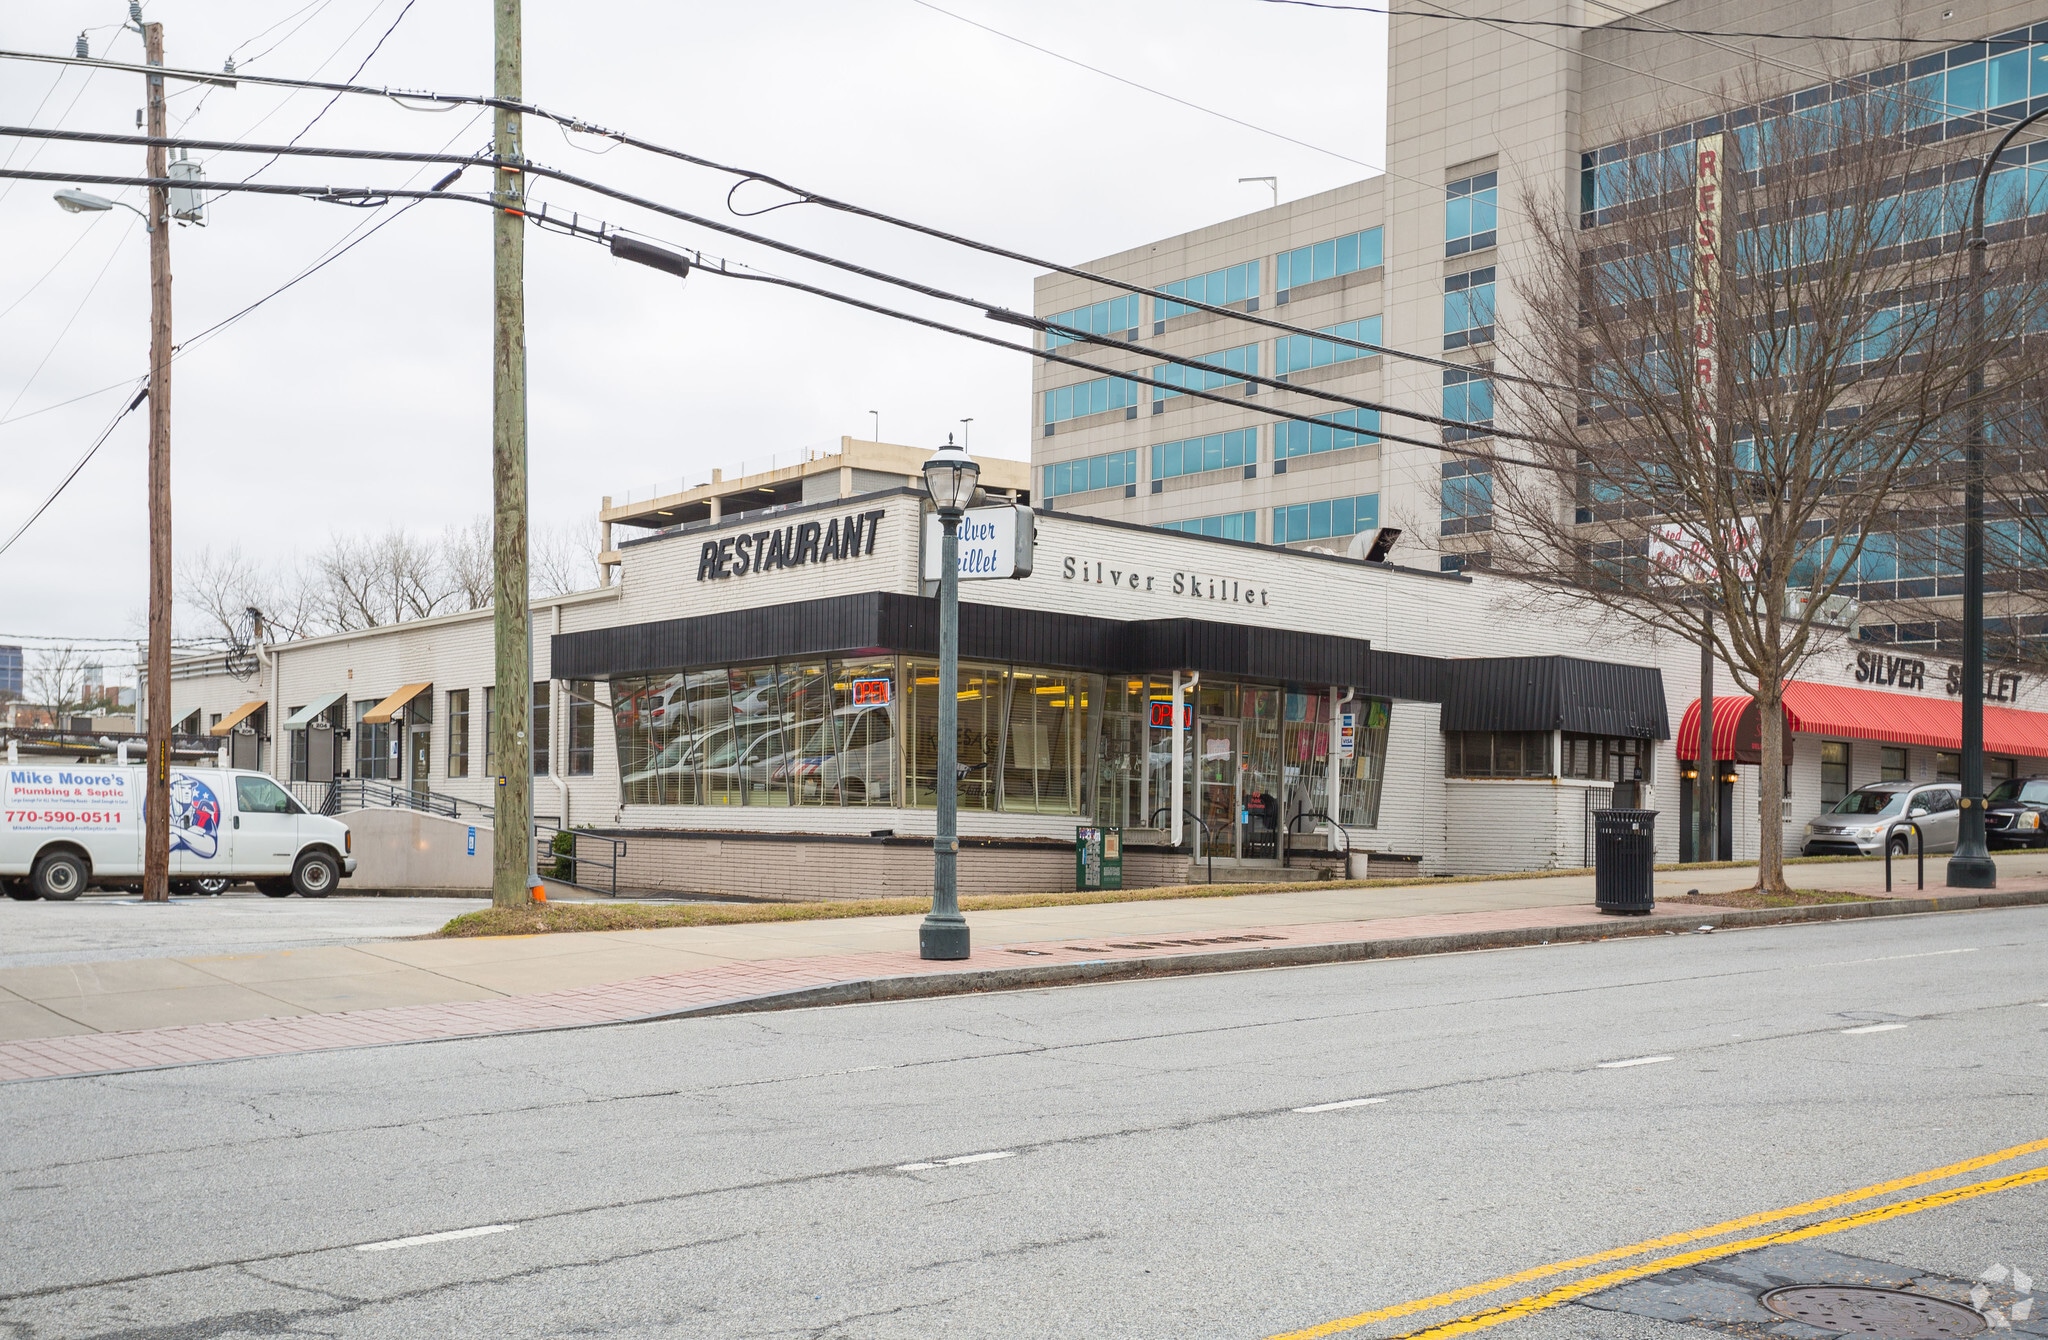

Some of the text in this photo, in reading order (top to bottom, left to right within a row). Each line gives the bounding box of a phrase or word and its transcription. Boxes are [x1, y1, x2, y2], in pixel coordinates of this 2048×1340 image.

[958, 516, 996, 542] ilver
[696, 509, 886, 581] RESTAURANT
[957, 548, 997, 573] illet
[1063, 555, 1270, 606] Silver Skillet
[1856, 651, 1925, 692] SILVER
[855, 681, 889, 704] OPEN
[11, 771, 125, 786] Mike Moore's
[14, 787, 124, 798] Plumbing & Septic
[5, 811, 121, 823] 770-590-0511
